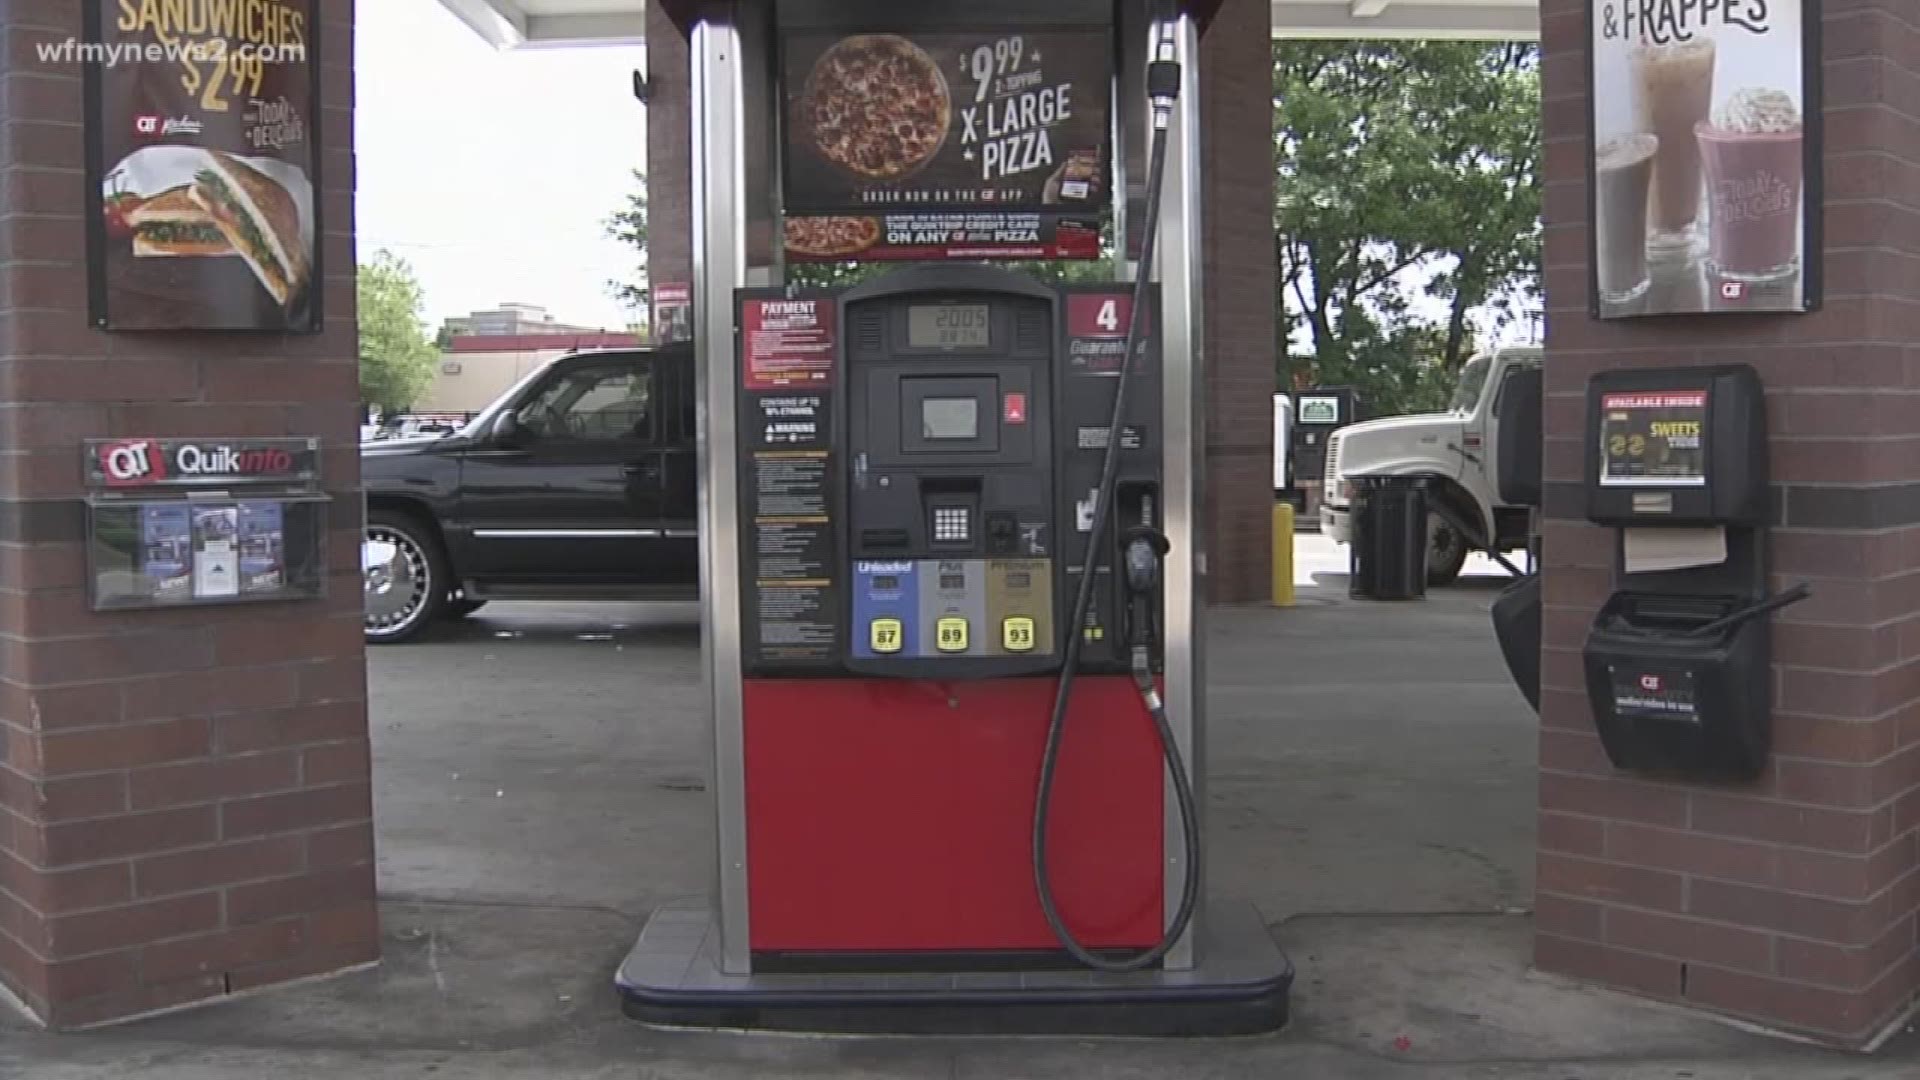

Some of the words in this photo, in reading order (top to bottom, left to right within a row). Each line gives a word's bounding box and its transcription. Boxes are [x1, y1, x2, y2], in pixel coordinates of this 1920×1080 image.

[117, 0, 304, 50] SANDWICHES
[983, 129, 1052, 181] PIZZA
[887, 232, 911, 243] ON
[914, 231, 949, 244] ANY
[994, 230, 1039, 242] PIZZA
[761, 301, 817, 315] PAYMENT
[1096, 300, 1118, 331] 4
[1650, 421, 1700, 437] SWEETS
[108, 442, 148, 480] QT
[877, 630, 896, 645] 87
[942, 629, 962, 643] 89
[1010, 629, 1030, 643] 93
